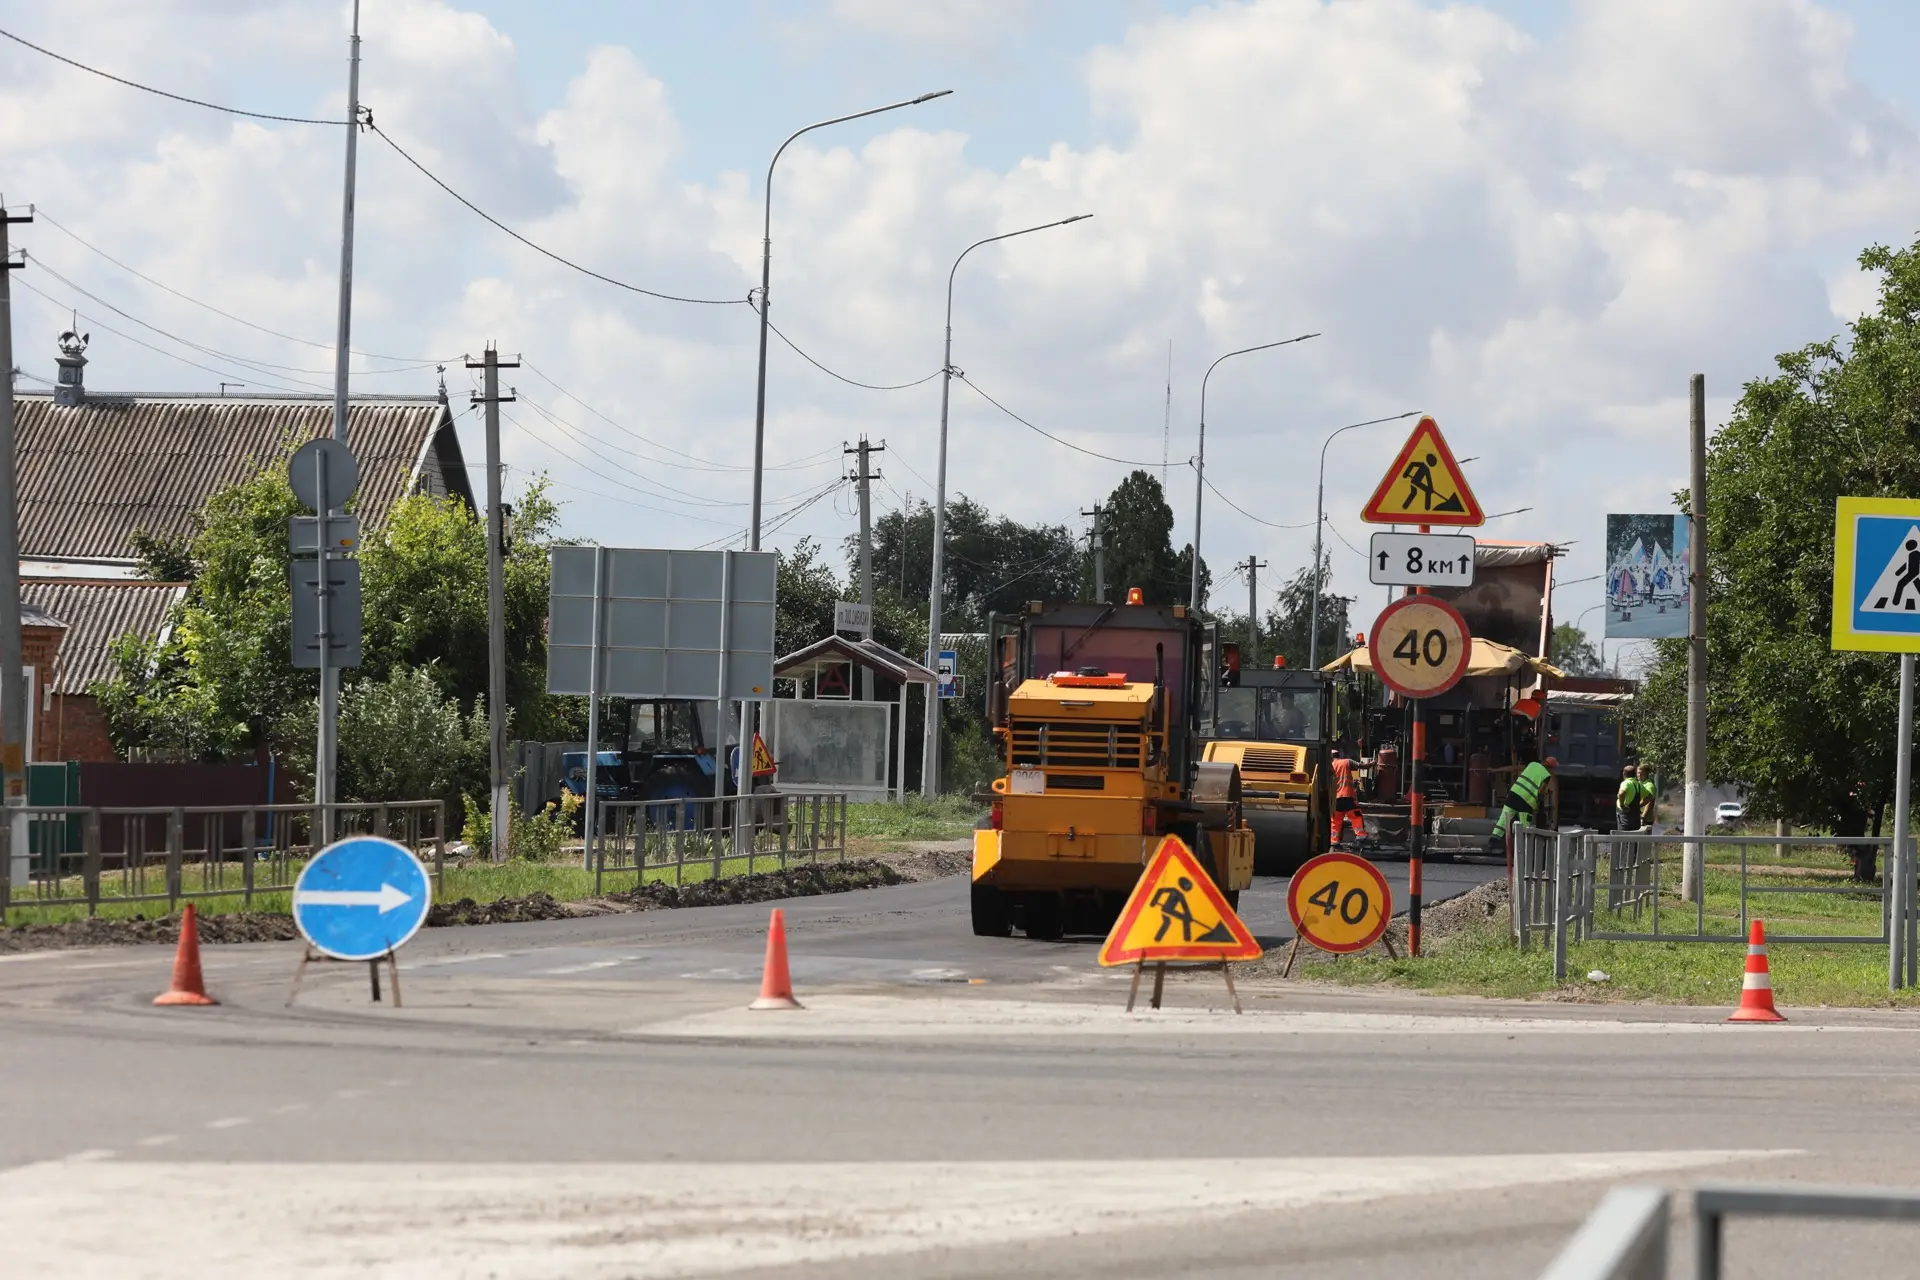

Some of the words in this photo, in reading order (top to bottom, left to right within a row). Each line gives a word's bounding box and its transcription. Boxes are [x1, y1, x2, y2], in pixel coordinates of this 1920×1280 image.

[1406, 547, 1423, 574] 8
[1393, 629, 1447, 667] 40
[1308, 880, 1369, 925] 40
